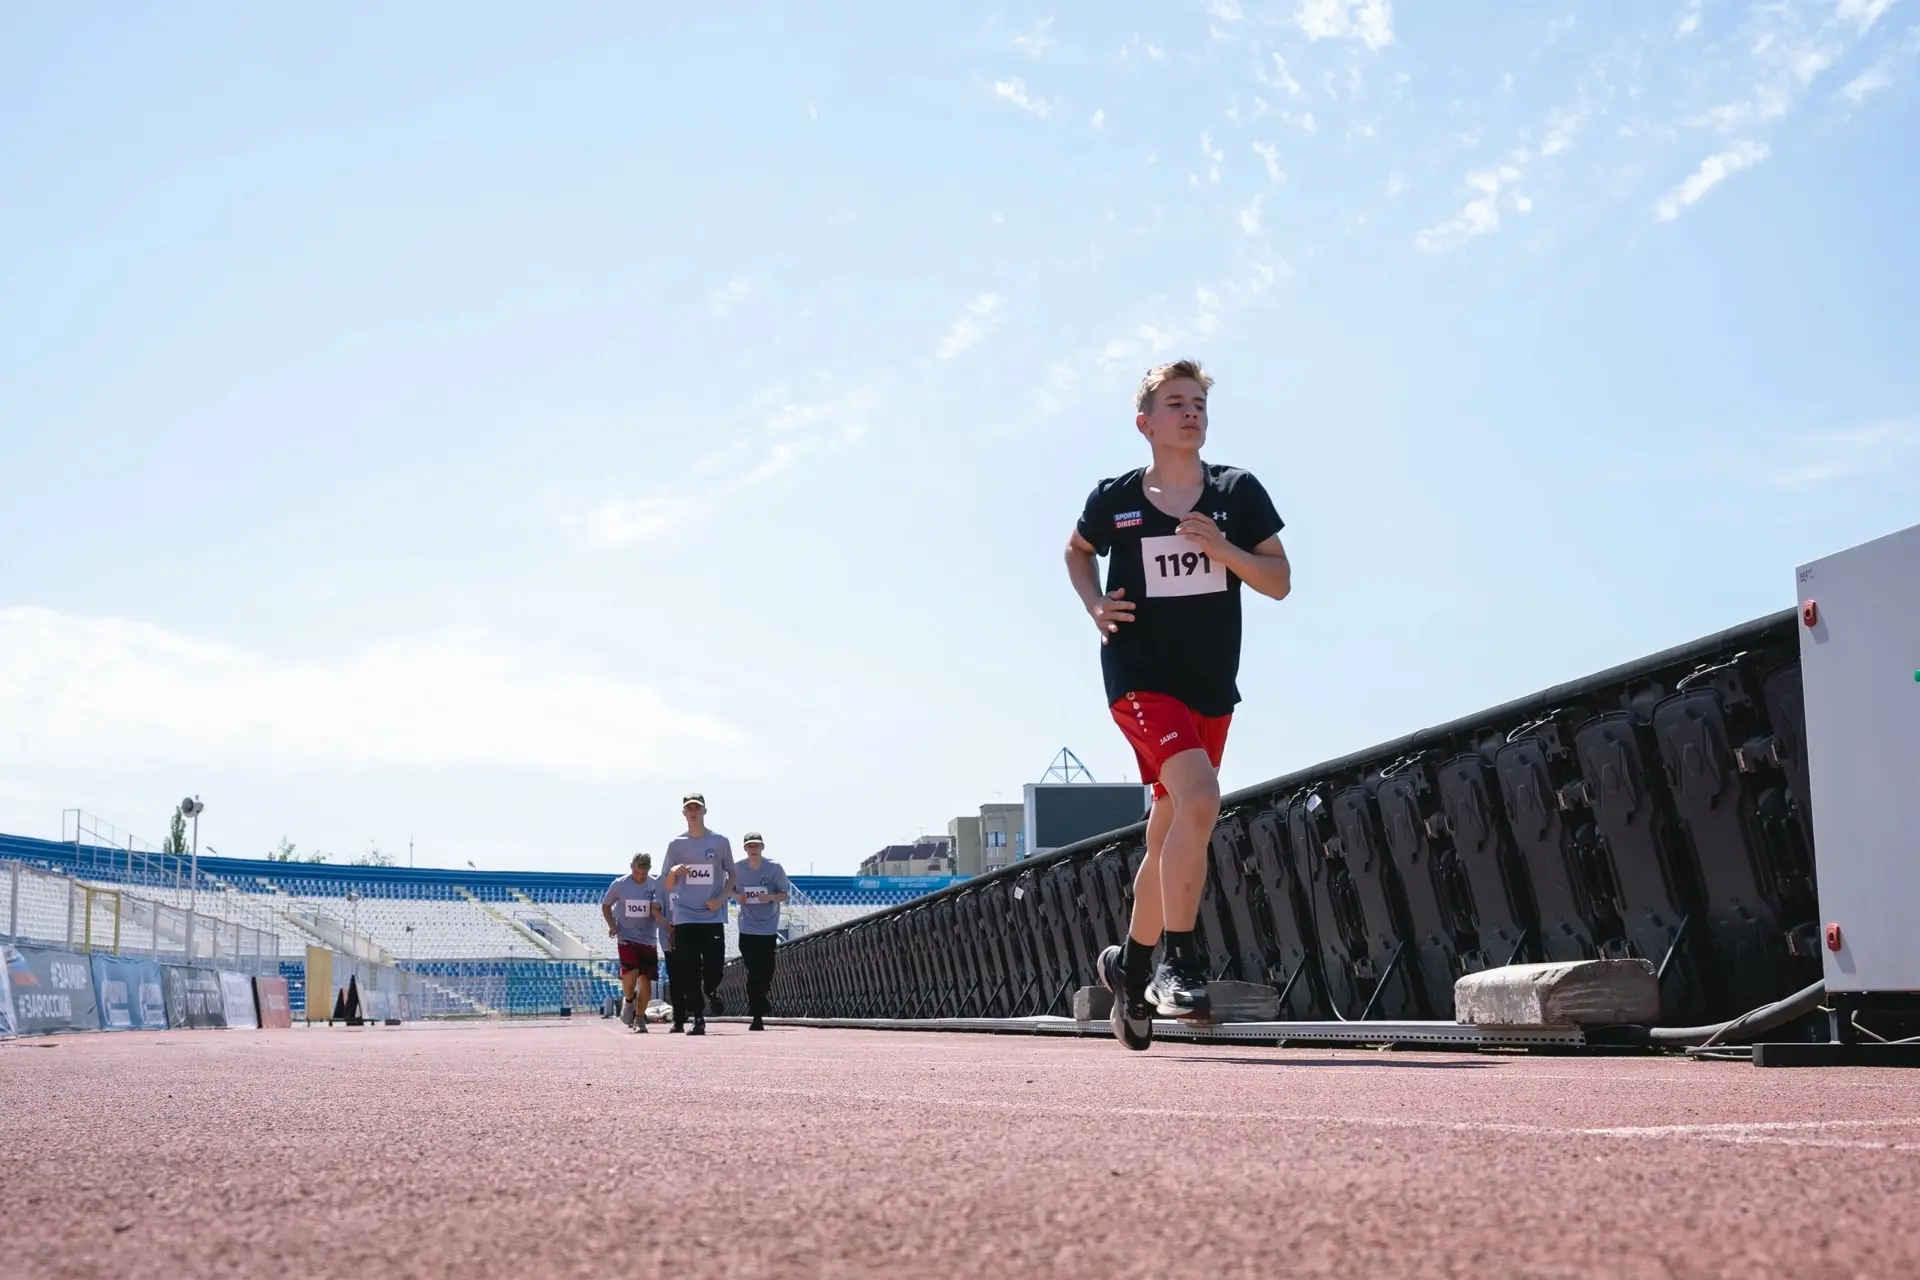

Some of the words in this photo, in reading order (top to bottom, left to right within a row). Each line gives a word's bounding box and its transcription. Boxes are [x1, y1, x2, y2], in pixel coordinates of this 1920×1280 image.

[1115, 511, 1141, 521] SPORTS
[1116, 519, 1141, 529] DIRECT
[1154, 551, 1211, 578] 1191
[1159, 731, 1178, 746] JAKO
[688, 869, 710, 879] 1044
[746, 890, 765, 899] 104
[628, 905, 647, 913] 1041
[50, 962, 87, 989] #ЗАМИР
[18, 994, 72, 1018] #ЗАРОССИЮ
